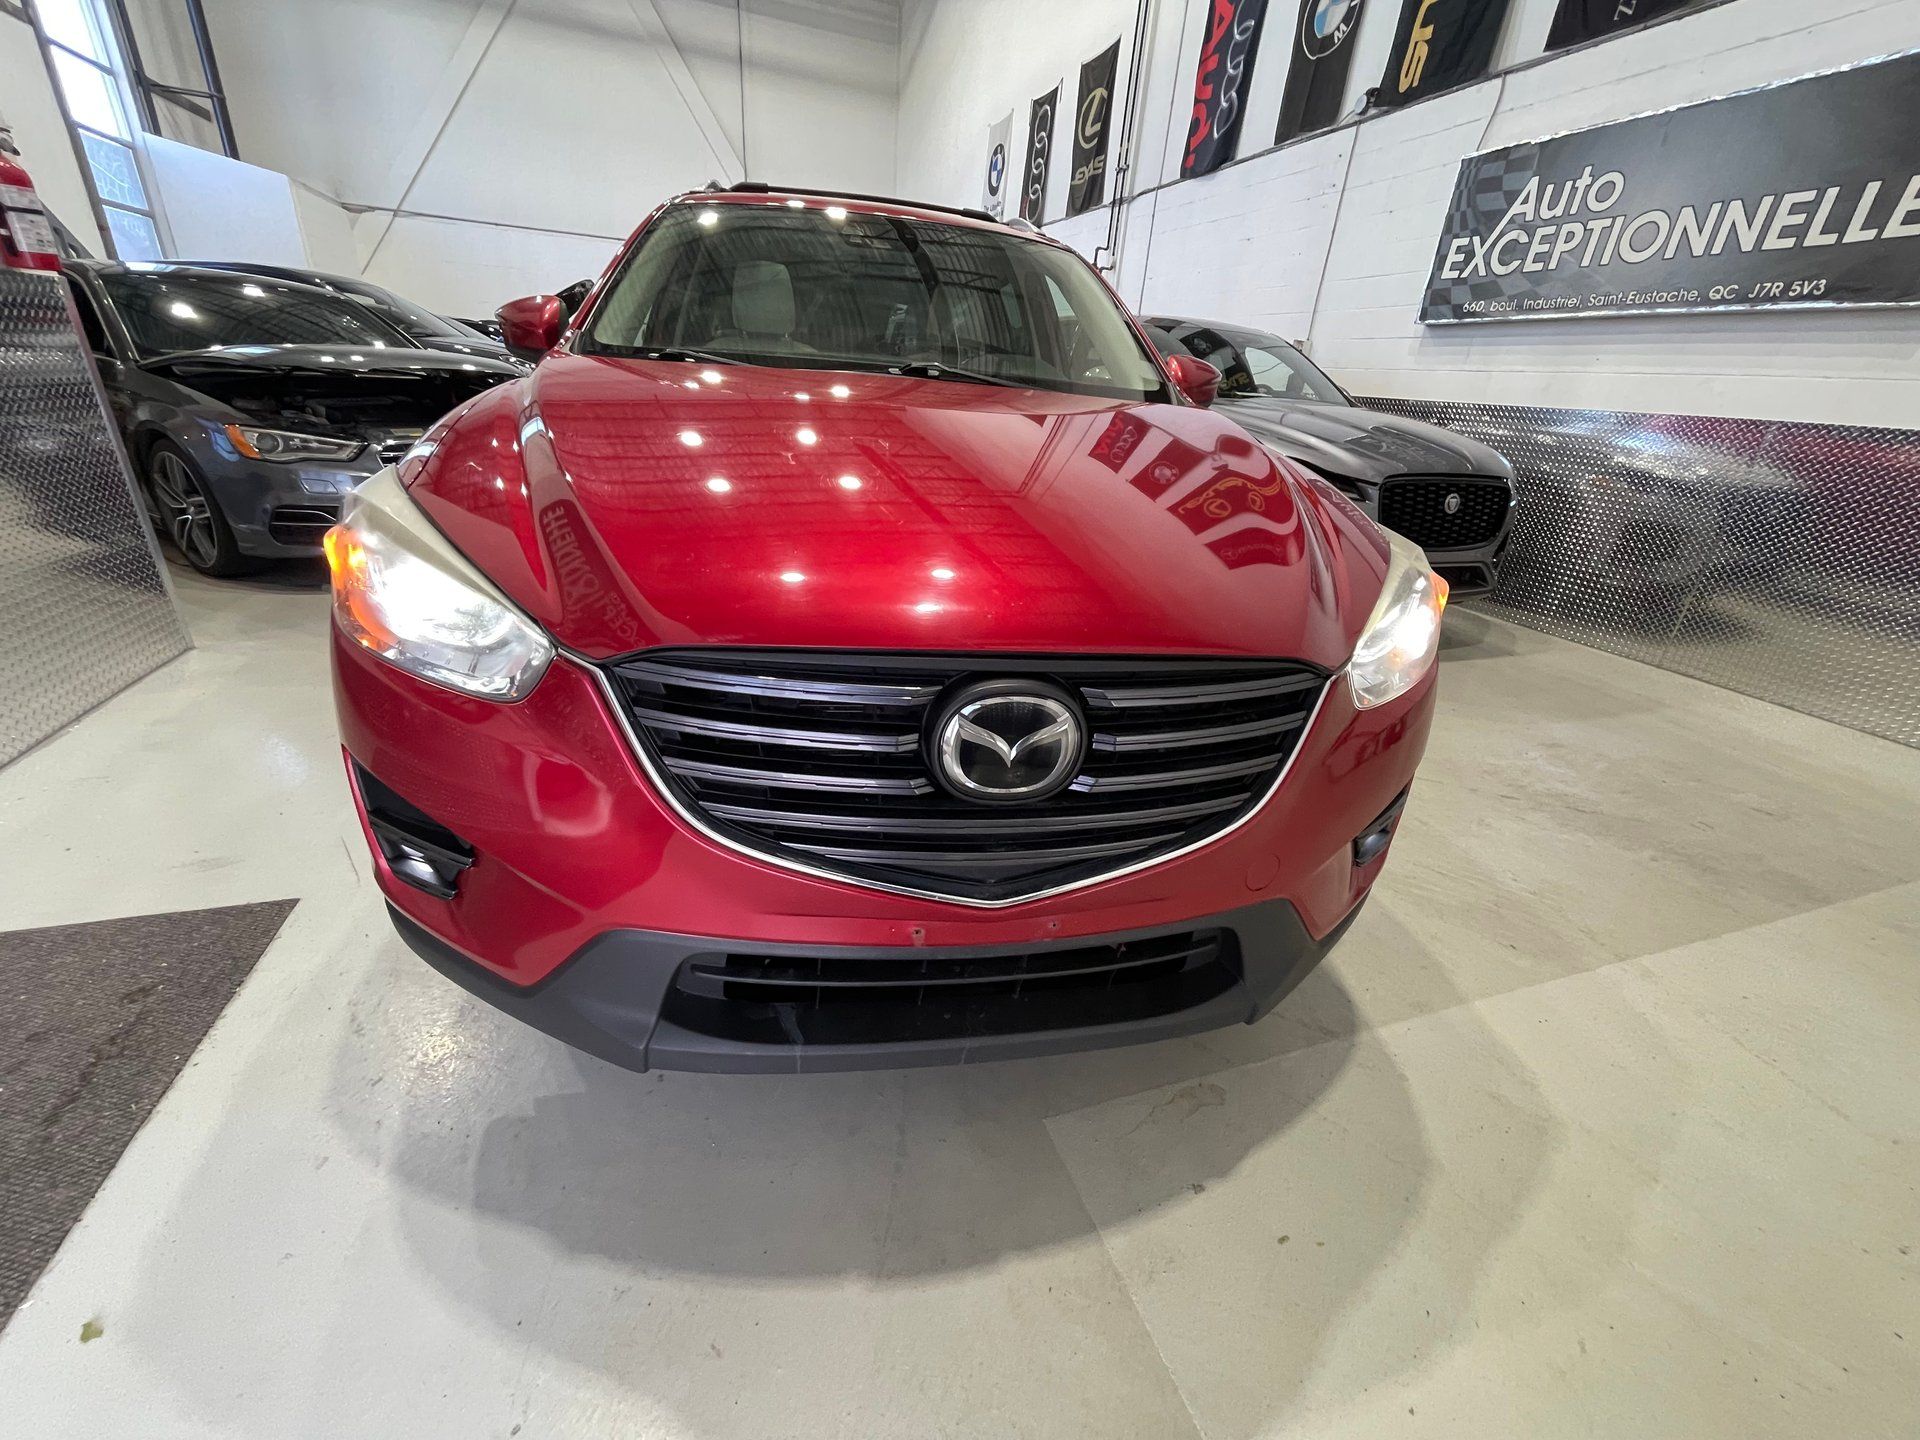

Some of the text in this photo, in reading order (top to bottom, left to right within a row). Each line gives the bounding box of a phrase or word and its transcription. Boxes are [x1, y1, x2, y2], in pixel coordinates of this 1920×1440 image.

[1440, 174, 1920, 280] EXCEPTIONNELLE
[1496, 165, 1625, 230] Auto
[1462, 278, 1828, 313] 660, boul. Industriel, Saint-Eustache, QC J7R 5V3
